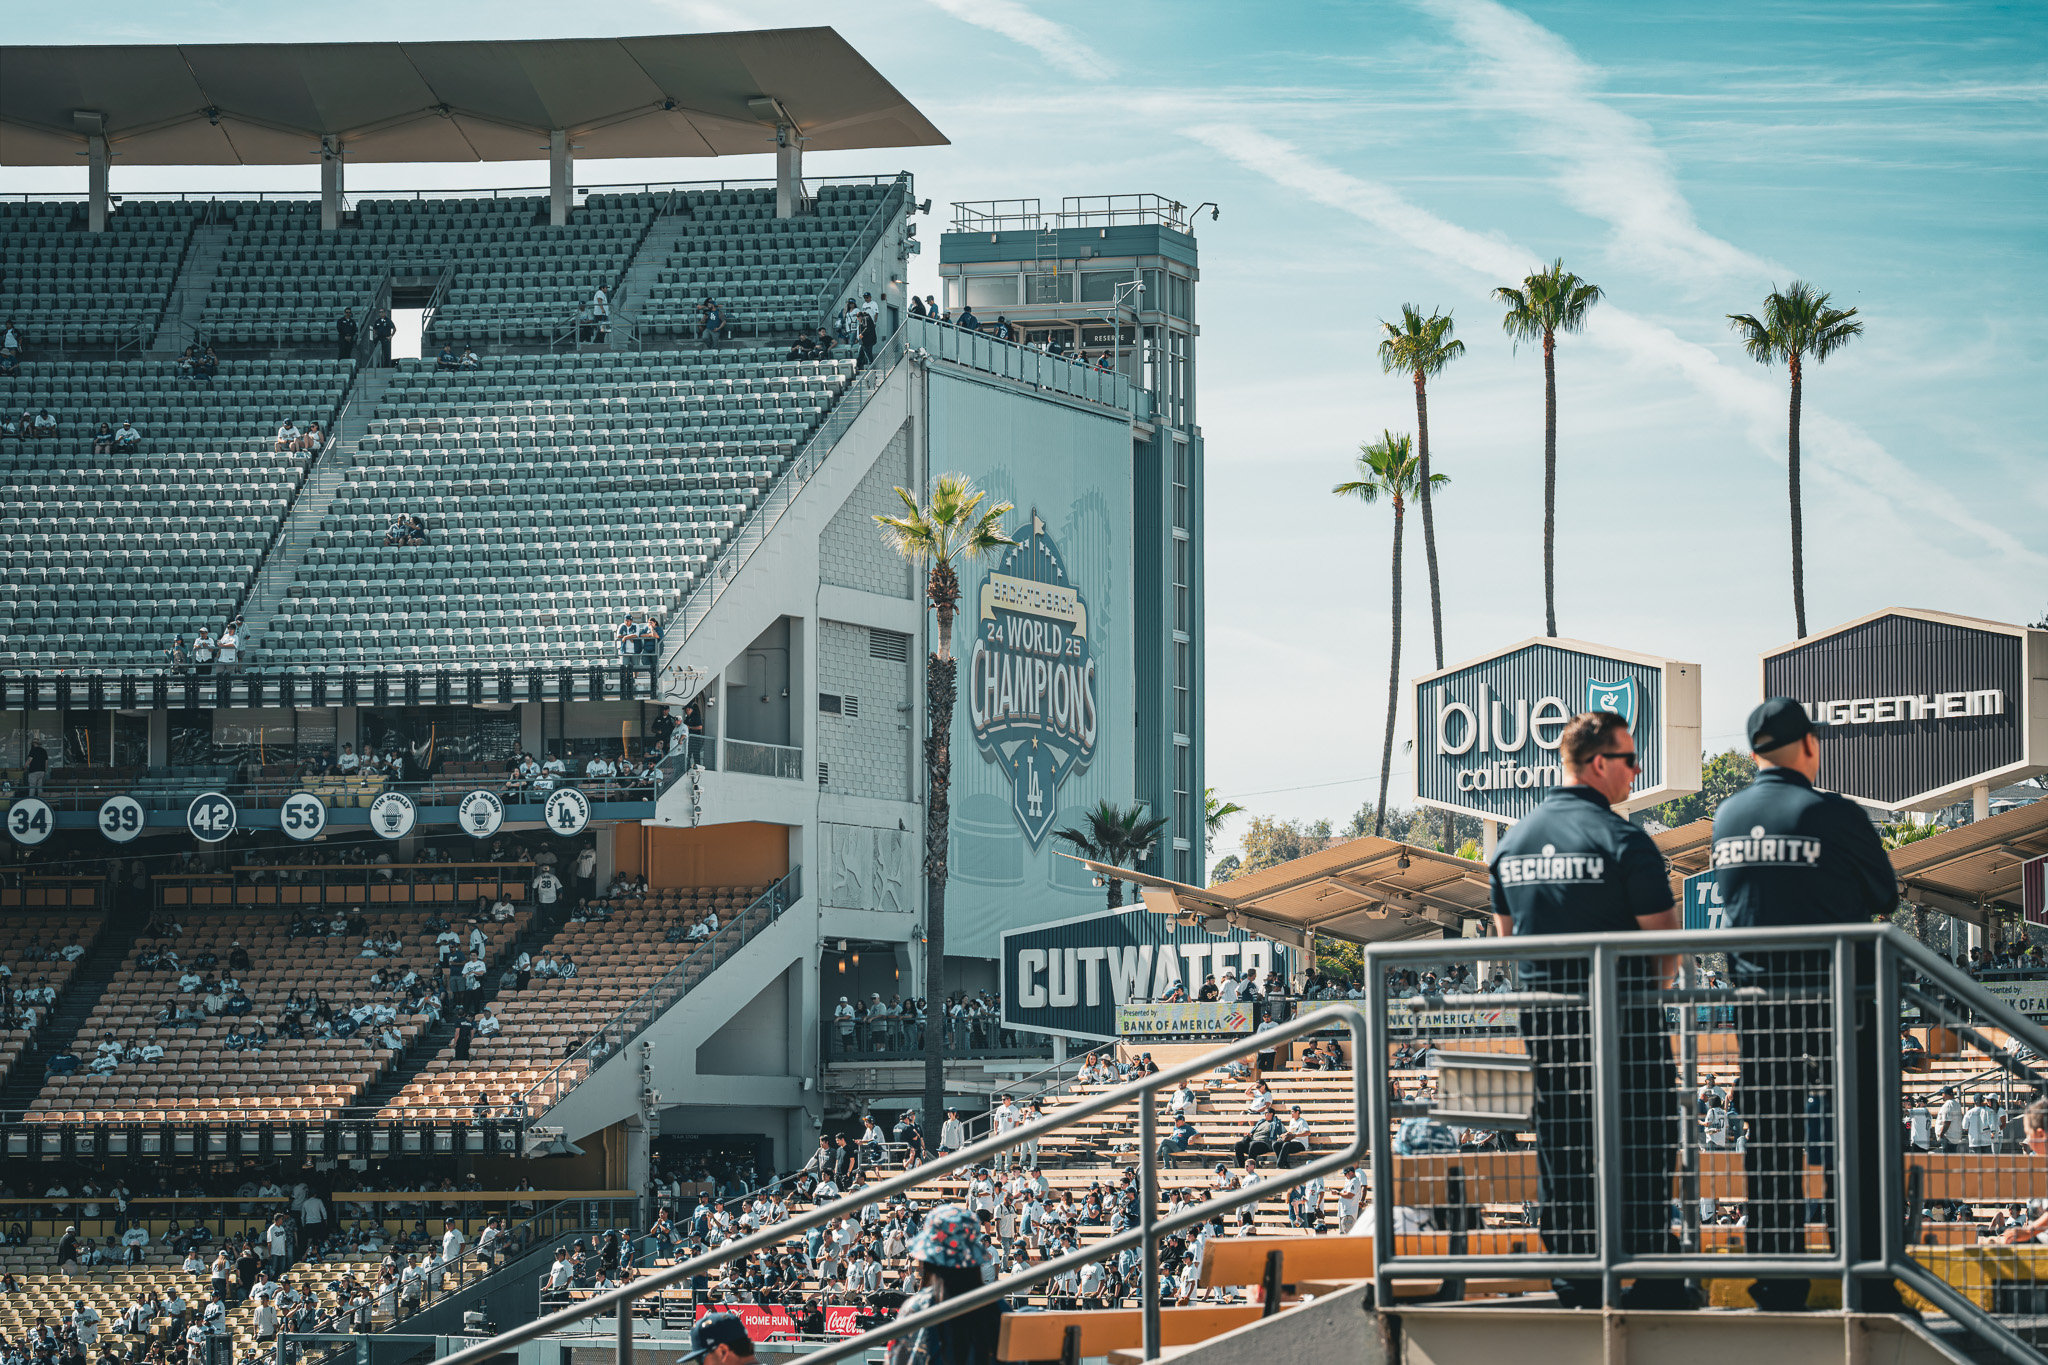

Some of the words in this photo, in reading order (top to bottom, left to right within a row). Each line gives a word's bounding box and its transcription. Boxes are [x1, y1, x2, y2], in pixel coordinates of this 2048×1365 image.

[993, 580, 1075, 615] BACK-TO-BACK
[987, 622, 1004, 643] 24
[1006, 615, 1062, 657] WORLD
[1065, 637, 1081, 657] 25
[969, 638, 1097, 749] CHAMPIONS
[1436, 682, 1571, 755] blue
[1799, 688, 2004, 726] UGGENHEIM
[1027, 756, 1043, 817] LA
[373, 798, 385, 811] VIN
[386, 794, 411, 810] SCULLY
[461, 794, 477, 815] JAIME
[547, 792, 563, 818] WALTER
[563, 791, 585, 817] O'MALLEY
[558, 803, 575, 828] LA
[12, 808, 47, 834] 34
[104, 806, 139, 832] 39
[193, 804, 230, 830] 42
[286, 803, 319, 829] 53
[1500, 857, 1604, 883] SECURITY
[541, 880, 552, 889] 38
[1018, 941, 1272, 1008] CUTWATER
[1123, 1009, 1149, 1017] Presented
[2019, 998, 2034, 1010] OF
[1123, 1020, 1152, 1031] BANK
[1155, 1020, 1170, 1030] OF
[1171, 1019, 1222, 1030] AMERICA
[1389, 1014, 1405, 1025] NK
[1424, 1013, 1476, 1024] AMERICA
[745, 1316, 770, 1326] HOME
[771, 1316, 789, 1326] RUN
